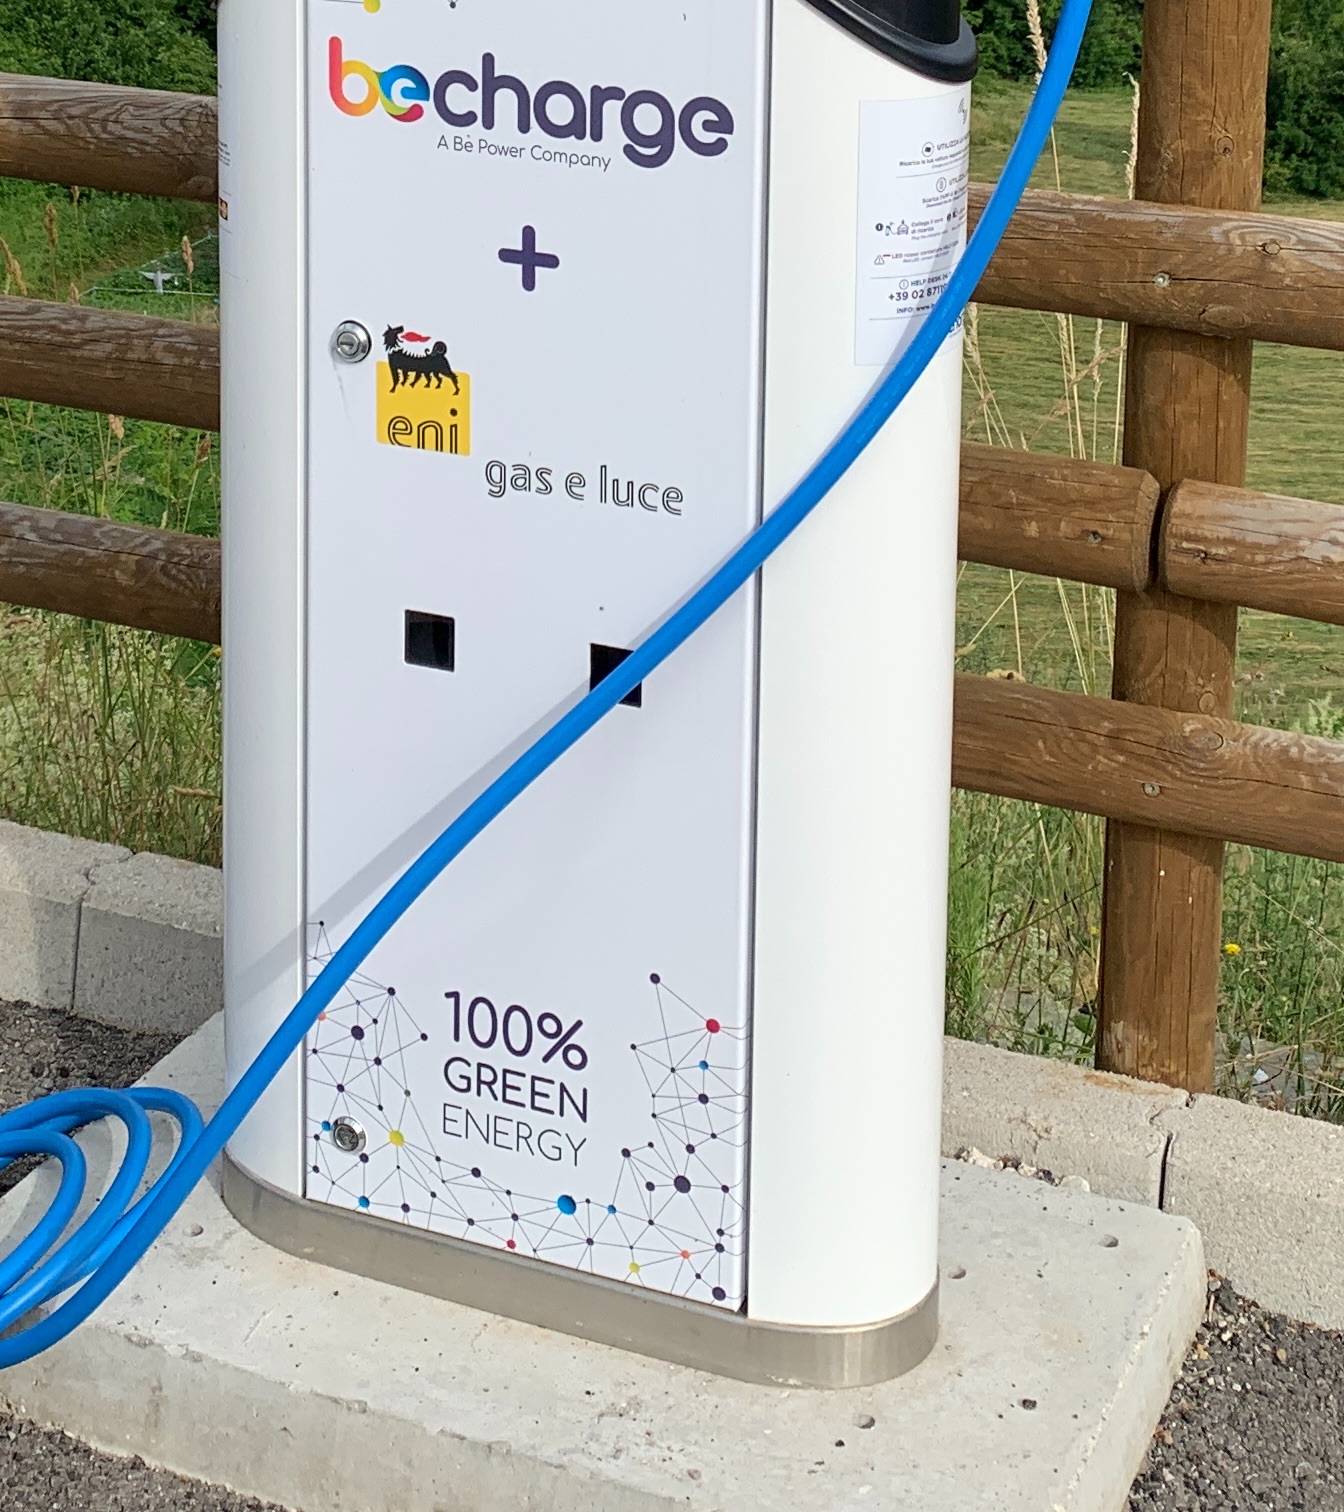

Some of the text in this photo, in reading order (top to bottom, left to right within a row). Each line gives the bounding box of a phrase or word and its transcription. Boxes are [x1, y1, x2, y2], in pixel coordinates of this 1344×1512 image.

[328, 36, 735, 169] becharge
[436, 135, 449, 150] A
[478, 138, 526, 159] Power
[530, 144, 612, 173] Company
[888, 291, 909, 302] +39
[911, 289, 925, 300] 02
[387, 407, 458, 455] eni
[485, 459, 684, 516] gas e luce
[444, 990, 589, 1071] 100%
[443, 1056, 588, 1124] GREEN
[442, 1102, 588, 1167] ENERGY
